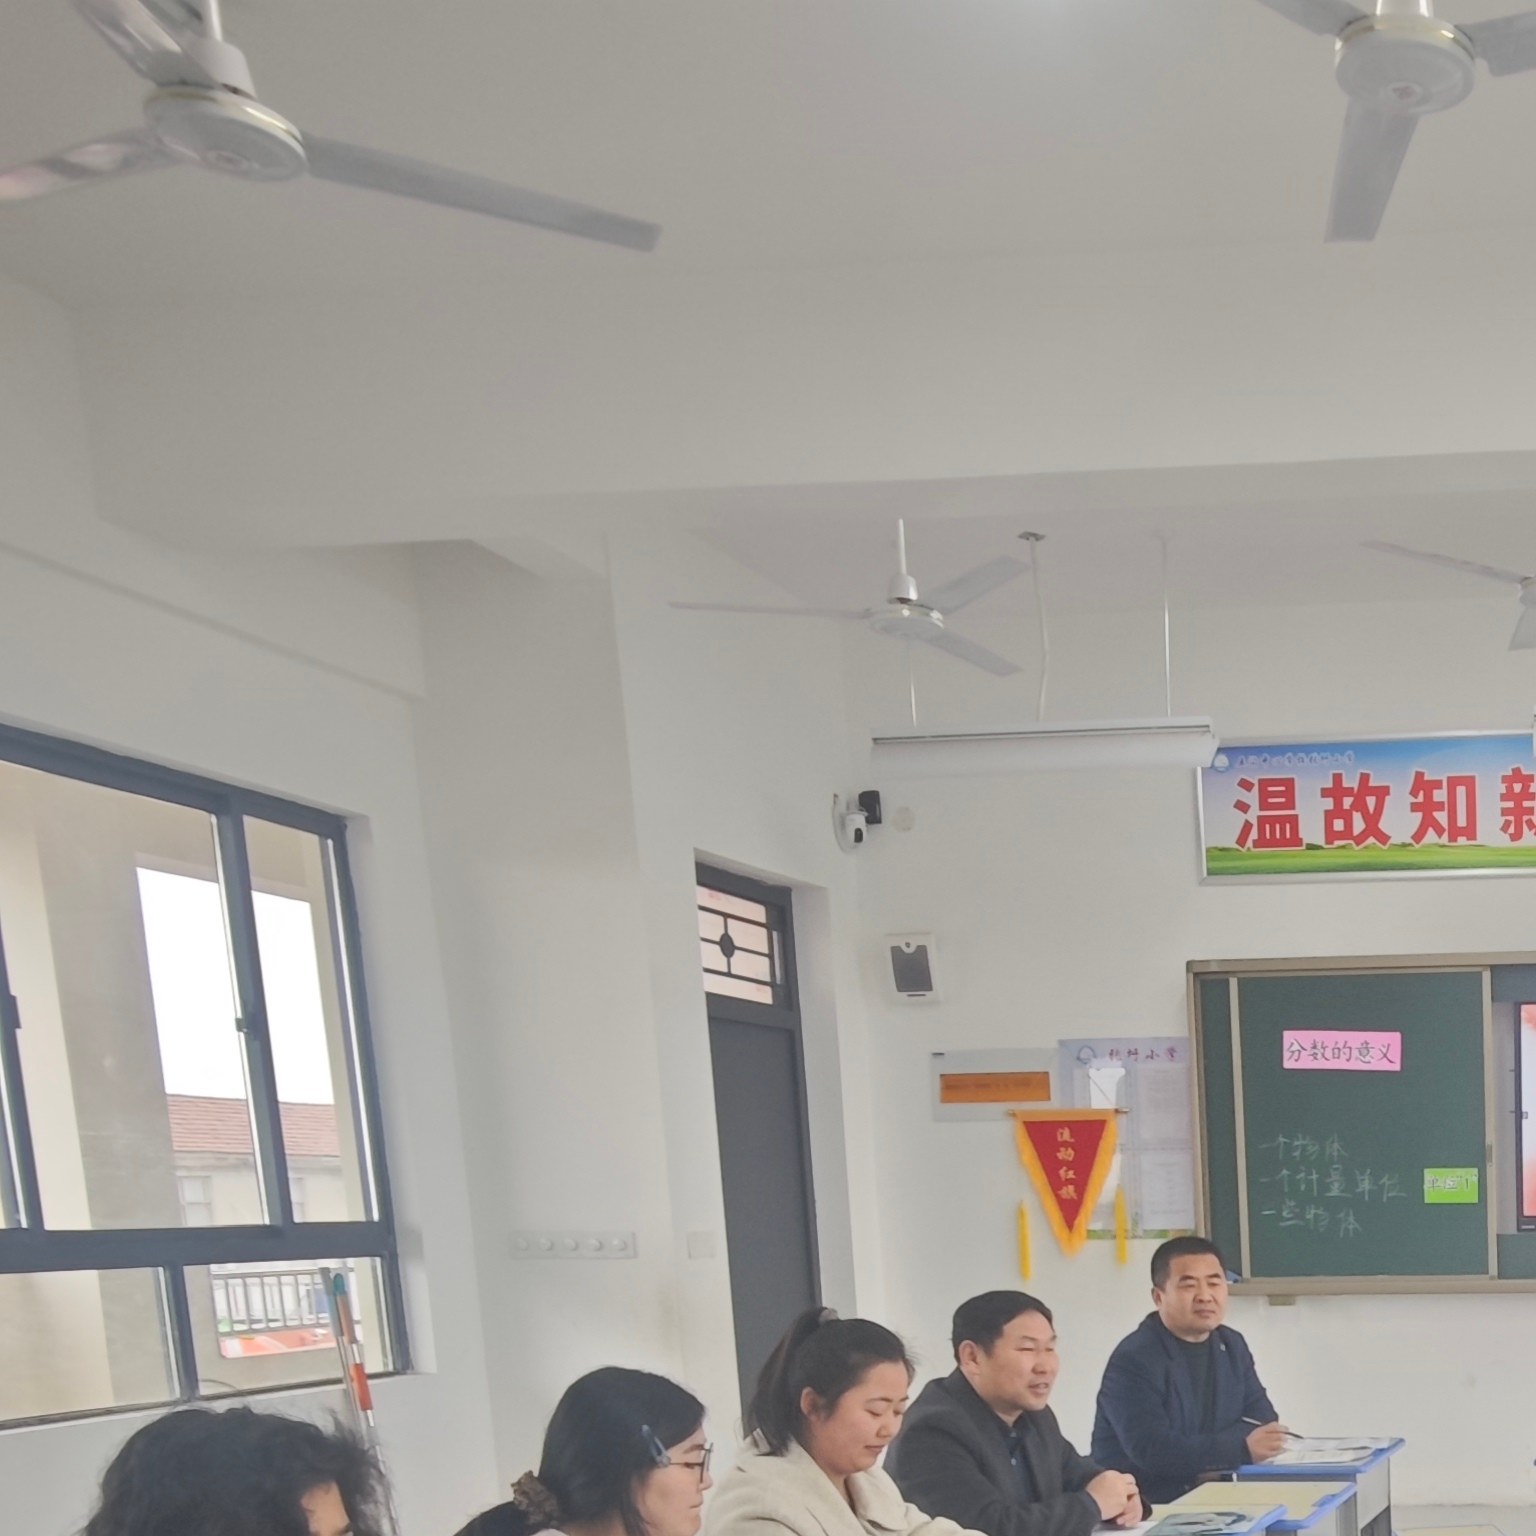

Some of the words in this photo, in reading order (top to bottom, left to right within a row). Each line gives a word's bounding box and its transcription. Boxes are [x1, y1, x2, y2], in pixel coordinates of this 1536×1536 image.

[1287, 1038, 1396, 1064] 分数的意义
